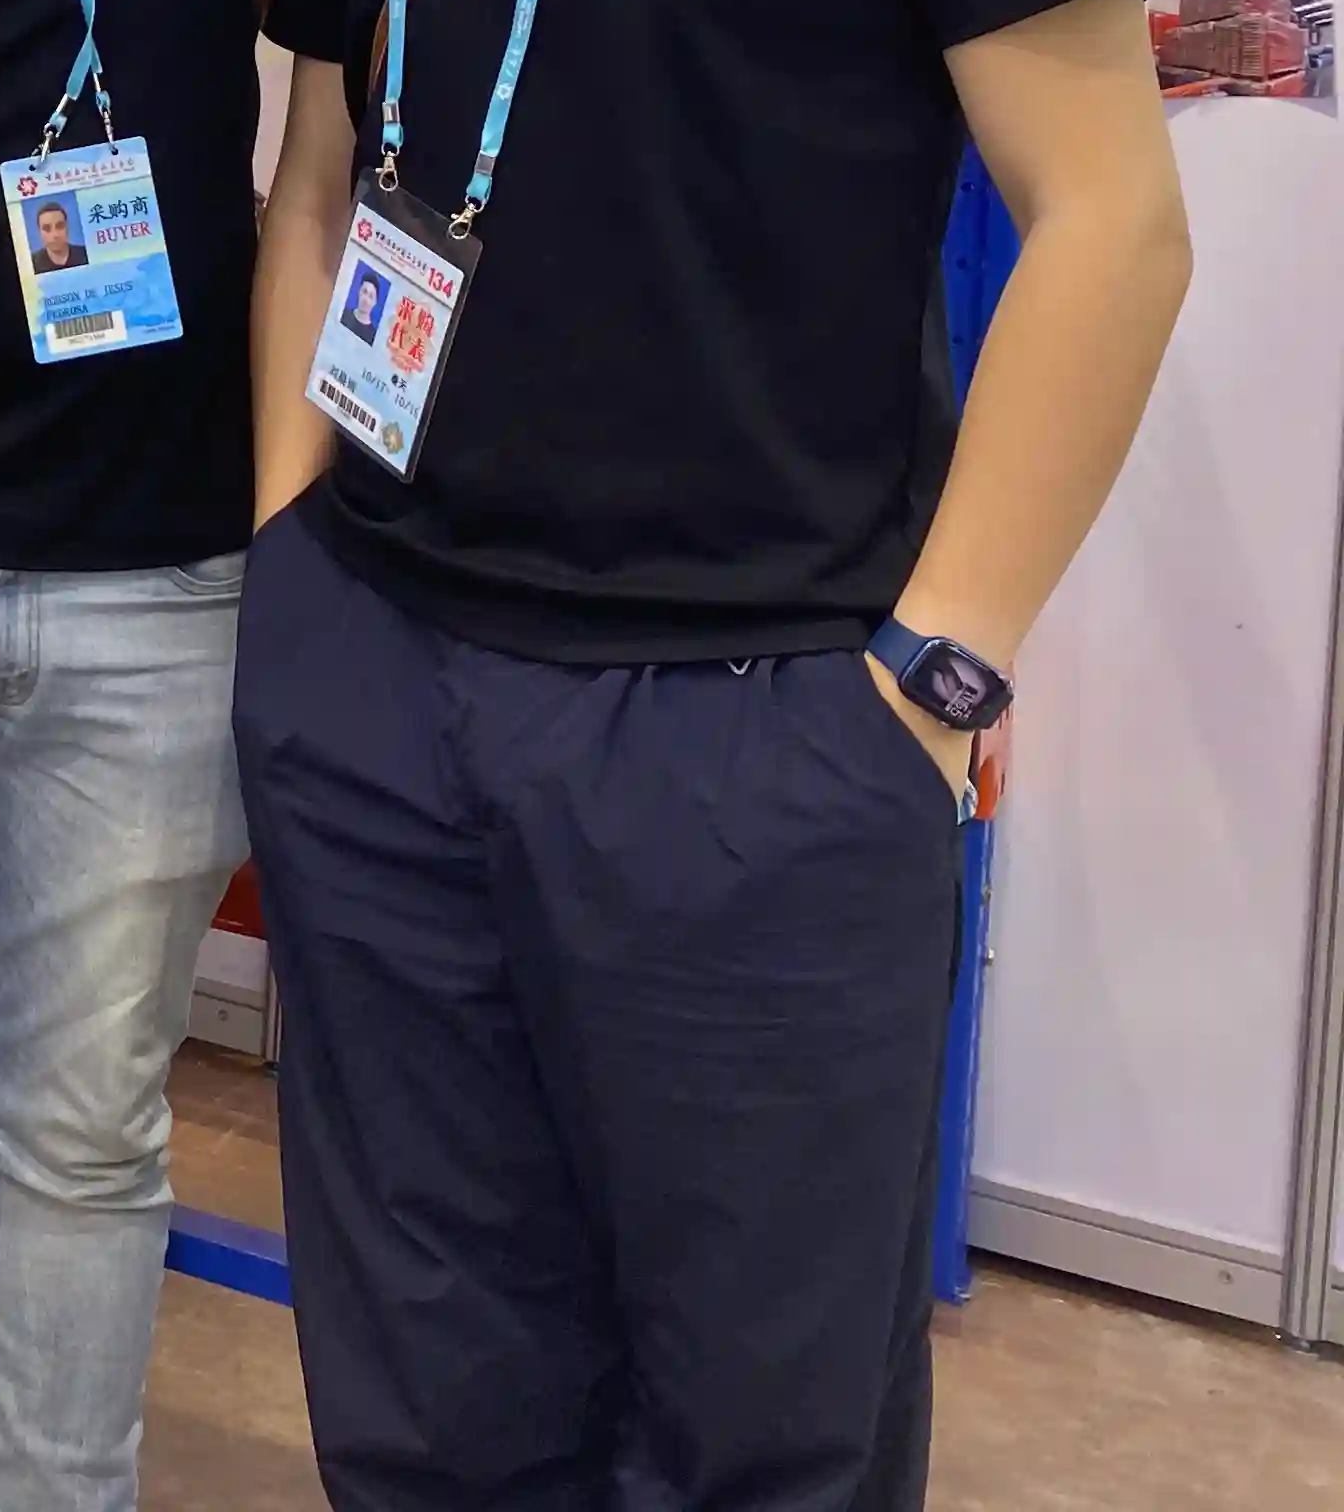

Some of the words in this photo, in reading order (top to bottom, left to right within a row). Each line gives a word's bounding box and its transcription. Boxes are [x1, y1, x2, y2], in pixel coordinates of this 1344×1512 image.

[88, 196, 150, 224] 采购商
[96, 221, 152, 245] BUYER
[427, 267, 455, 300] 134
